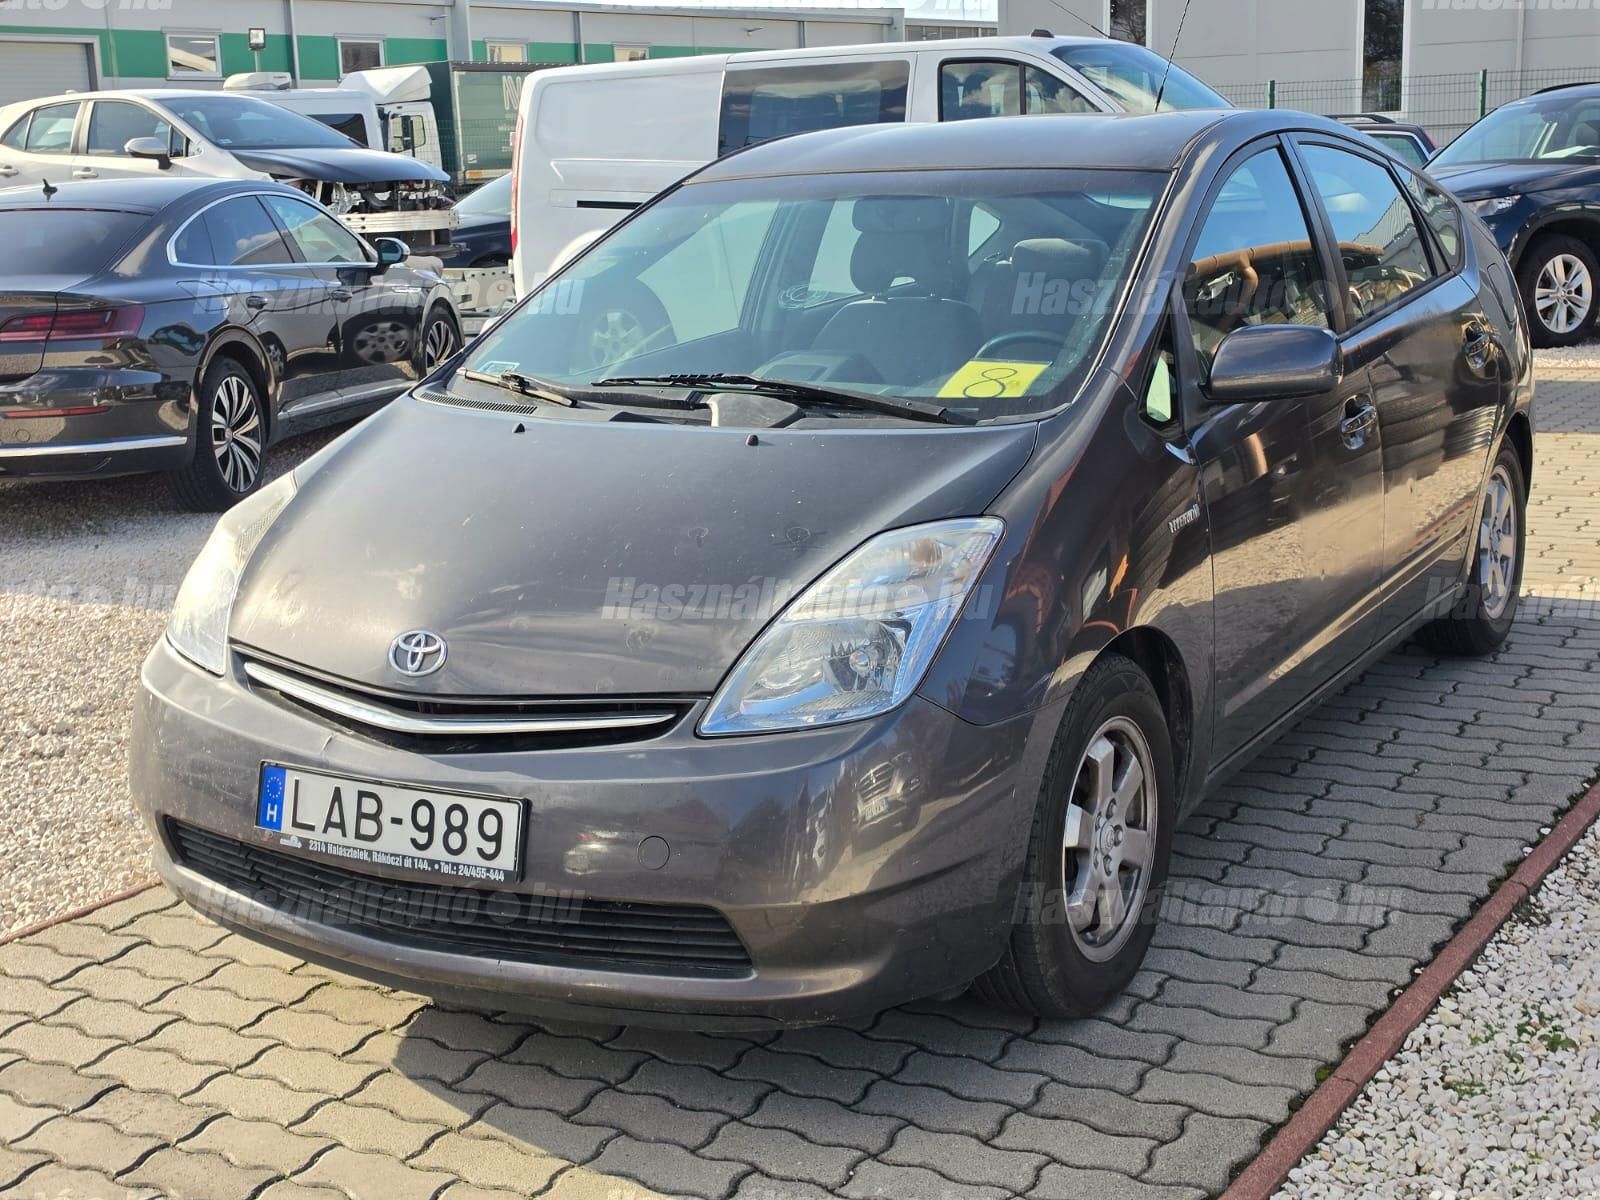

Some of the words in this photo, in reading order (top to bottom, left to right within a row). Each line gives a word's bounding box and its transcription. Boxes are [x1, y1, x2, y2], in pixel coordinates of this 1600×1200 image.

[962, 367, 1018, 399] 8
[266, 802, 278, 823] H
[291, 778, 504, 862] LAB-989
[308, 839, 326, 854] 2314
[458, 863, 505, 882] 24/455-444
